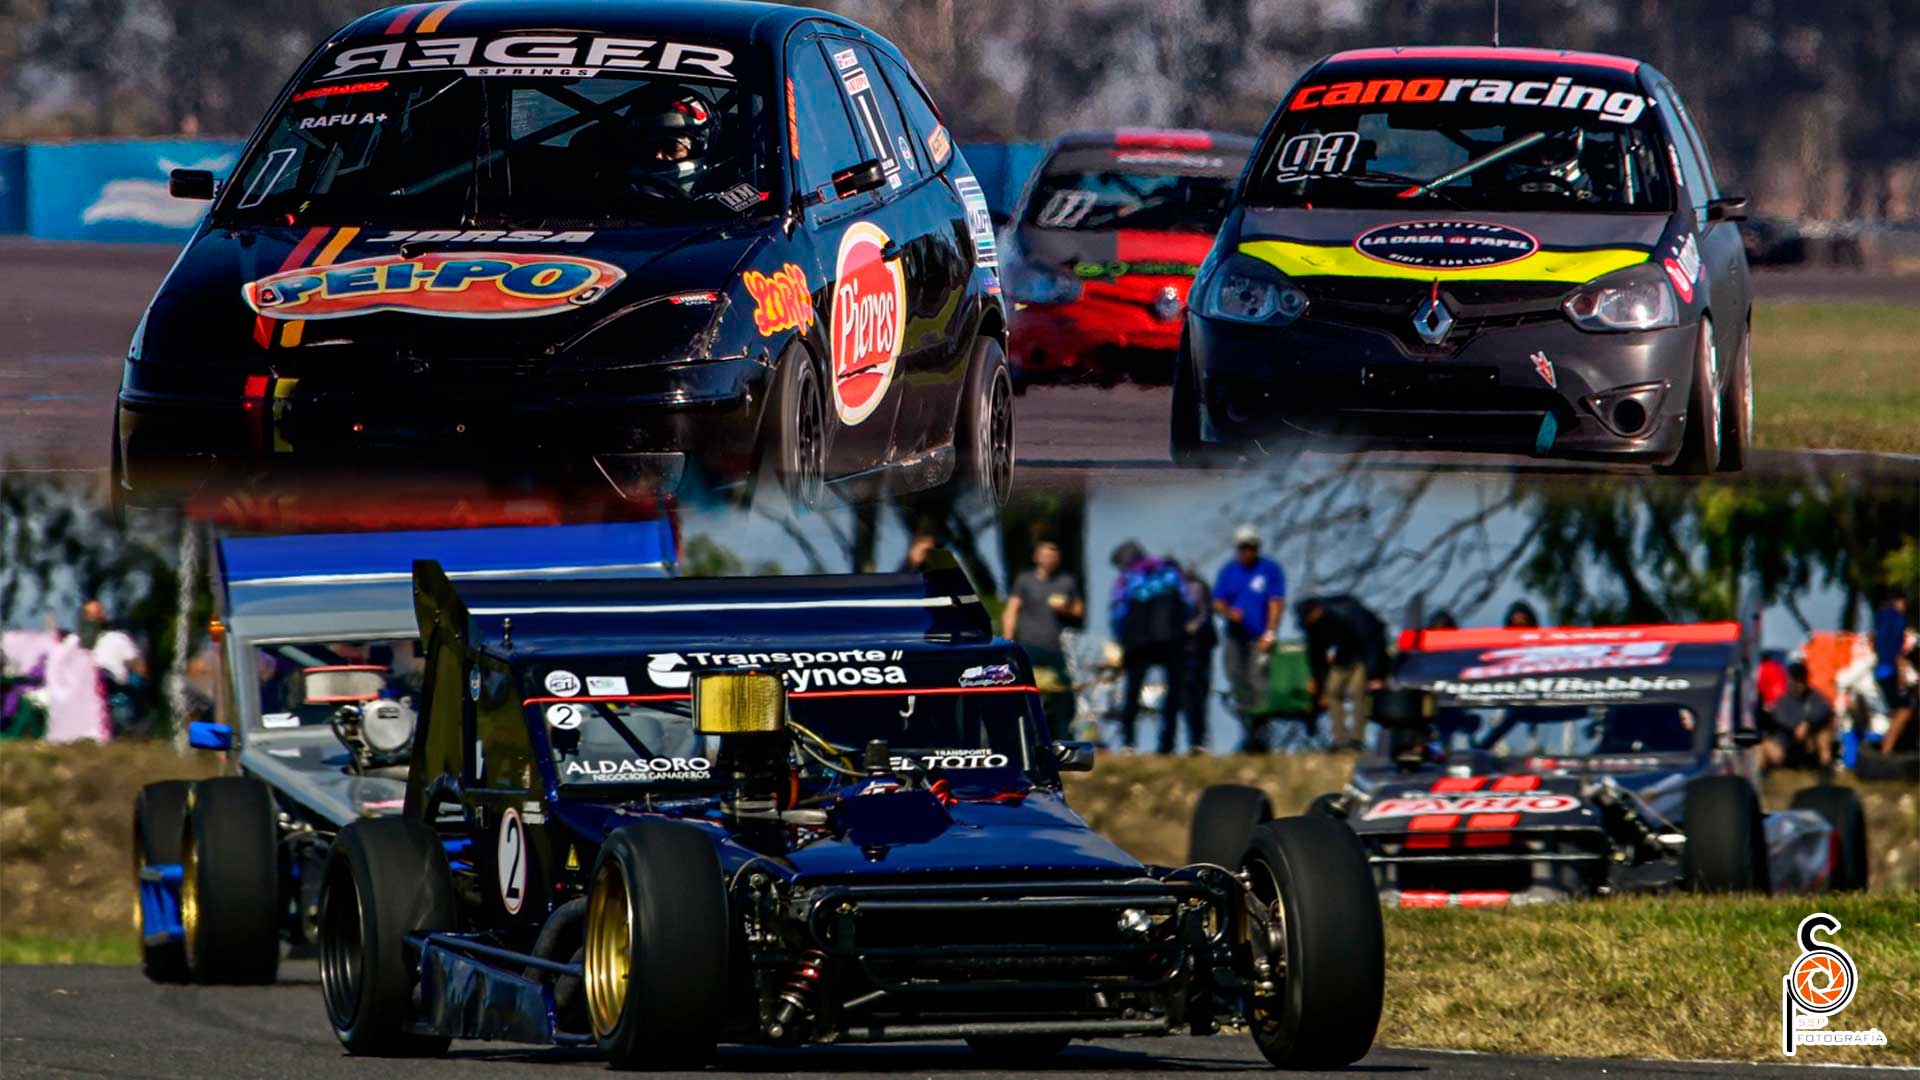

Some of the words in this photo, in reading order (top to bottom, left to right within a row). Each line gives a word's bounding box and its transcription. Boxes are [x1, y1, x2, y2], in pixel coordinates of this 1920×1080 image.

[477, 68, 592, 77] SPRINGS
[1288, 76, 1650, 124] canoracing
[300, 113, 357, 130] RAFU
[359, 112, 388, 125] A+
[365, 230, 596, 243] JORSA
[1362, 235, 1388, 246] LA
[1389, 235, 1445, 245] CASA
[1469, 236, 1530, 250] PAPEL
[269, 257, 600, 306] PEI-PO
[837, 282, 896, 374] Pieres
[687, 649, 887, 669] Transporte
[556, 705, 574, 727] 2
[934, 748, 993, 757] TRANSPORTE
[565, 757, 711, 776] ALDASORO
[920, 754, 1009, 771] TOTO
[593, 773, 648, 782] NEGOCIOS
[649, 770, 712, 781] GANADEROS
[505, 818, 522, 900] 2
